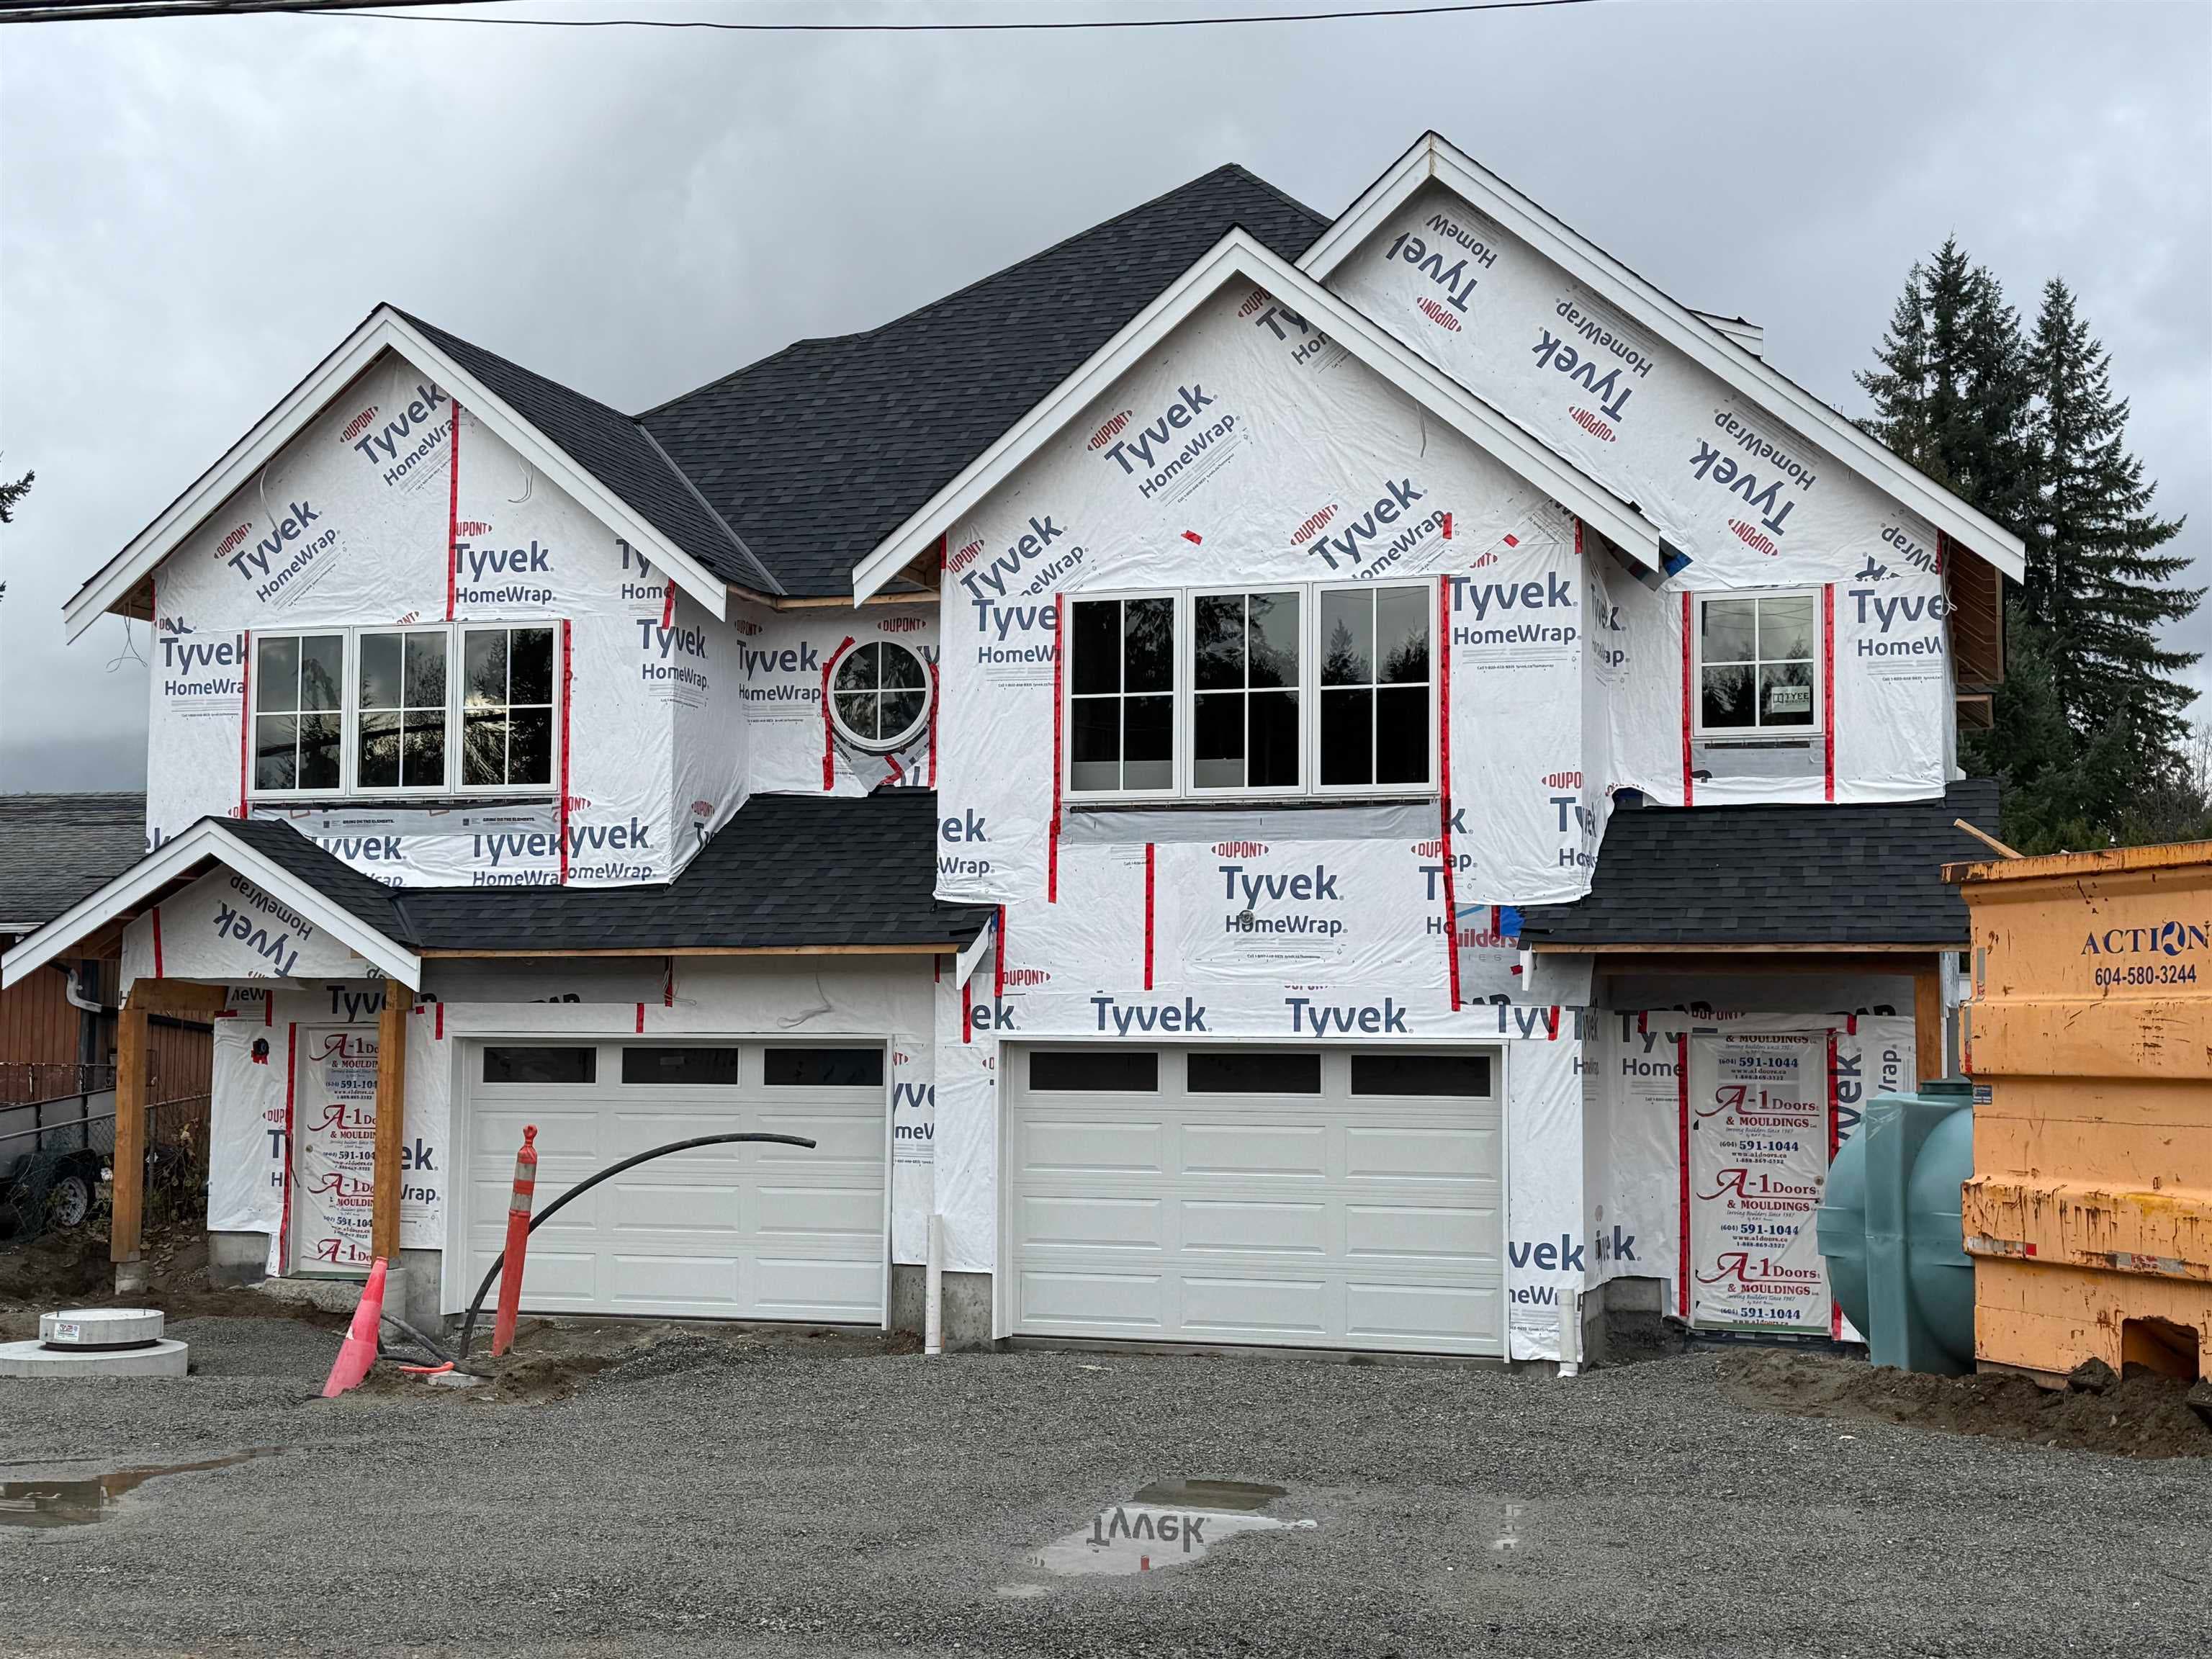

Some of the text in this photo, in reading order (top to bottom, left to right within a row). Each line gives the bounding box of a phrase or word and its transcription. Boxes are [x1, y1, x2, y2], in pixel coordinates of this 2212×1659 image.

[1426, 214, 1498, 269] HomeW
[1421, 297, 1458, 332] DUPONT
[1556, 300, 1654, 378] HomeWrap
[1532, 329, 1633, 423] Tyvek
[343, 407, 376, 441] DUPONT
[354, 383, 449, 465] Tyvek
[1091, 411, 1128, 449] DUPONT
[1104, 384, 1213, 475] Tyvek
[1573, 407, 1612, 441] DUPONT
[383, 418, 455, 487] HomeWra
[1138, 414, 1236, 499] HomeWrap
[1714, 412, 1816, 492] HomeWrap
[1689, 441, 1796, 536] Tyvek
[217, 523, 250, 557] DUPONT
[228, 500, 319, 581] Tyvek
[456, 521, 487, 536] UPONT
[1293, 505, 1333, 544] DUPONT
[1308, 477, 1424, 570] Tyvek
[1731, 518, 1774, 555] DUPONT
[256, 529, 336, 603] HomeWrap
[451, 541, 549, 582] Tyvek
[960, 515, 1064, 599] Tyvek
[455, 585, 552, 605] HomeWrap
[1449, 572, 1572, 621] Tyvek
[1848, 589, 1942, 633] Tyve
[736, 619, 757, 636] DUPONT
[883, 617, 922, 632] DUPONT
[972, 598, 1059, 641] Tyve
[1454, 624, 1577, 646] HomeWrap
[637, 618, 706, 658] Tyvek
[978, 644, 1056, 663] HomeW
[1858, 637, 1943, 657] HomeW
[642, 663, 708, 691] HomeWrap
[737, 640, 819, 680] Tyvek
[164, 678, 246, 696] HomeWra
[738, 683, 822, 703] HomeWrap
[569, 817, 649, 860] yvek
[1218, 841, 1264, 858] DUPONT
[568, 863, 652, 883] omeWrap
[939, 856, 991, 877] Wrap
[1218, 865, 1339, 909] Tyvek
[230, 874, 313, 940] HomeWrap
[212, 902, 299, 977] Tyvek
[1226, 915, 1342, 937] HomeWrap
[2095, 963, 2197, 986] 604-580-3244
[1090, 997, 1207, 1036] Tyvek
[1285, 997, 1408, 1037] Tyvek
[1739, 1057, 1798, 1068] 591-1044
[1726, 1117, 1735, 1125] &
[1740, 1118, 1809, 1128] MOULDINGS
[1772, 1098, 1815, 1111] Doors
[1740, 1141, 1799, 1151] 591-1044
[1727, 1200, 1809, 1212] & MOULDINGS
[1773, 1182, 1816, 1195] Doors
[1740, 1224, 1799, 1235] 591-1044
[1509, 1233, 1584, 1272] vek
[1741, 1284, 1810, 1295] MOULDINGS
[1773, 1265, 1817, 1279] Doors
[1740, 1308, 1800, 1319] 591-1044
